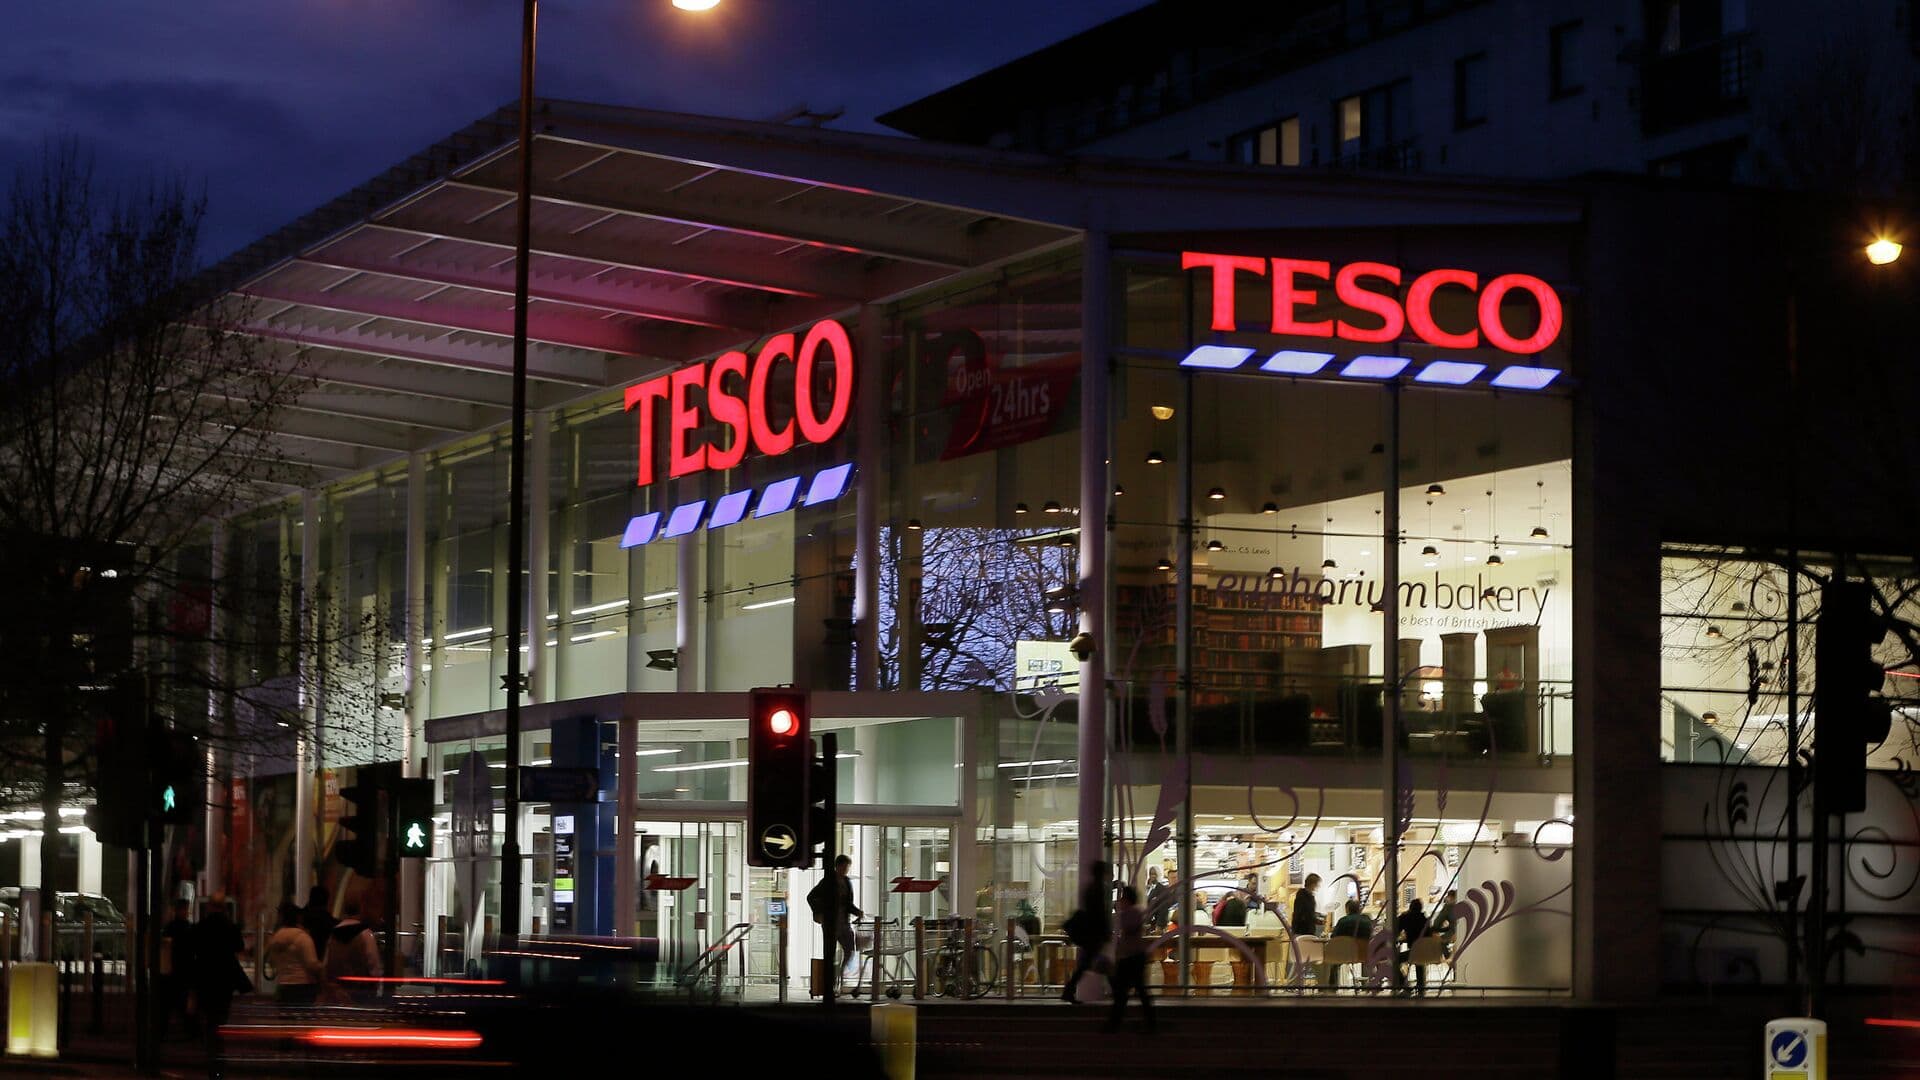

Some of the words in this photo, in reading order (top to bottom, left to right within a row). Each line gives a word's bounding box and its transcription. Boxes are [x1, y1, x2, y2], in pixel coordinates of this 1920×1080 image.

[1181, 251, 1563, 354] TESCO
[624, 319, 853, 486] TESCO
[956, 366, 991, 397] Open
[992, 377, 1051, 424] 24hrs
[1216, 567, 1428, 613] euphorium
[1435, 571, 1550, 625] bakery
[1410, 614, 1433, 626] best
[1437, 615, 1450, 628] of
[1452, 616, 1488, 630] British
